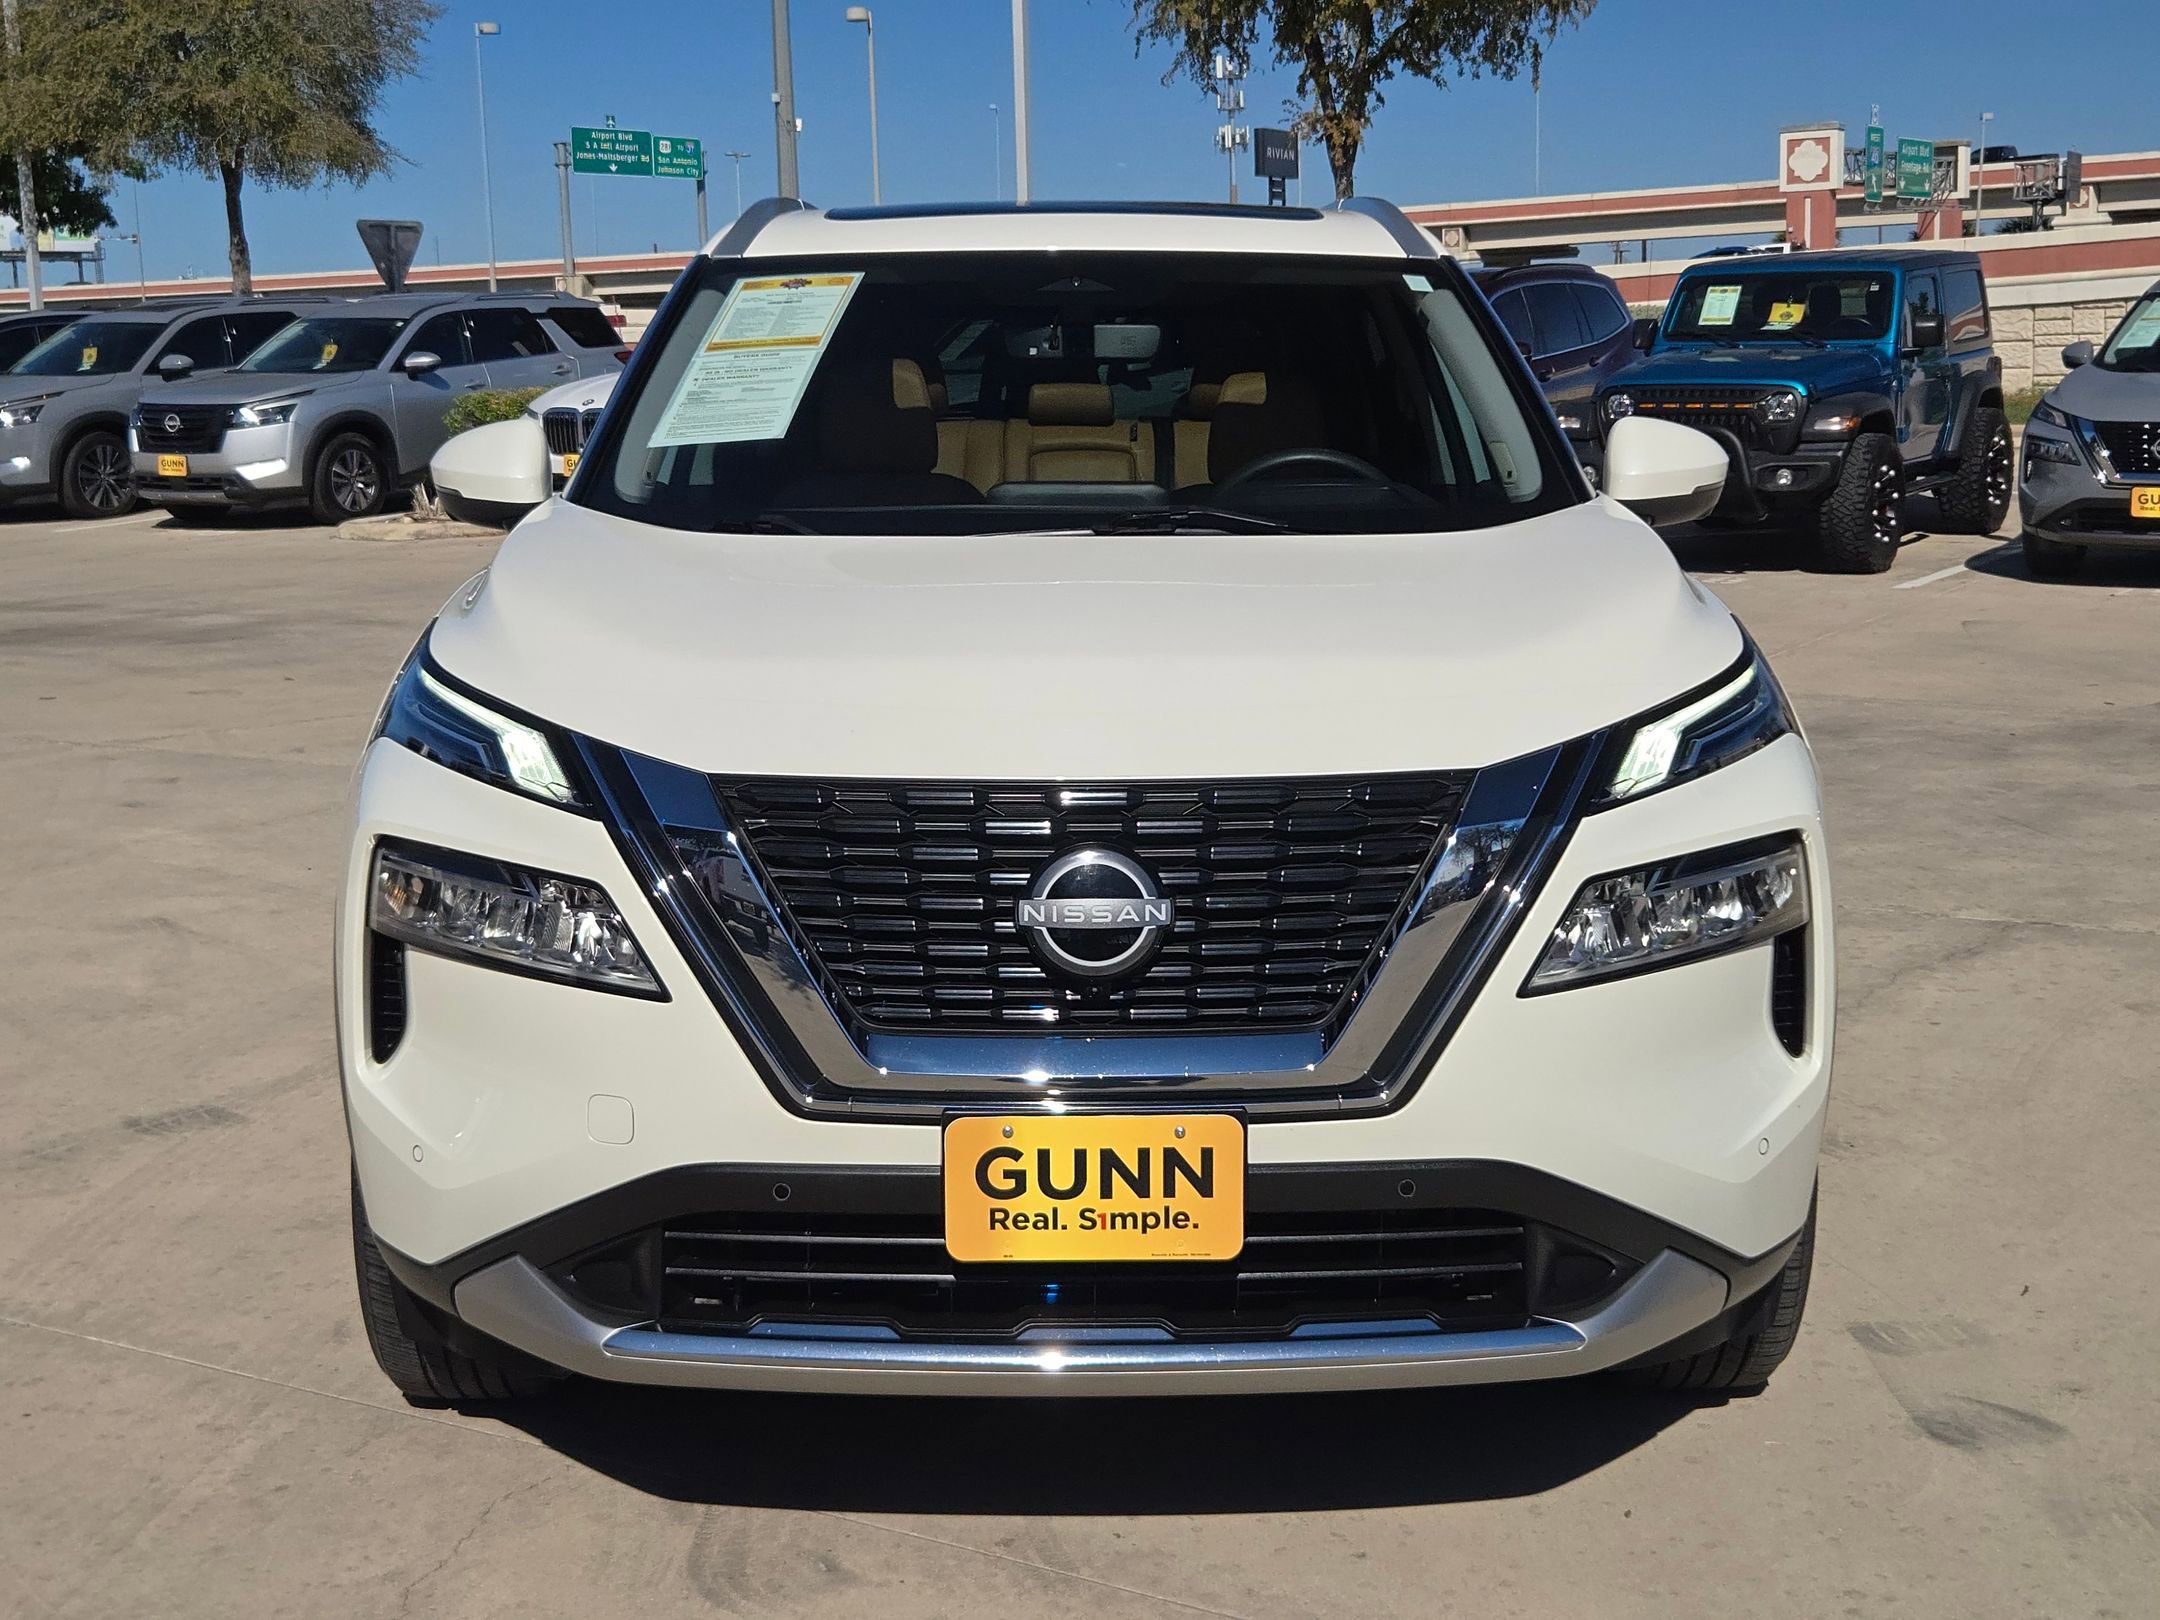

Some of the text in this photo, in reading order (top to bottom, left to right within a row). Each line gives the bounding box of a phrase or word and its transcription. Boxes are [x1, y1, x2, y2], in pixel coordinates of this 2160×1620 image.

[591, 131, 633, 141] Airport Blvd
[585, 141, 591, 149] S
[615, 143, 639, 153] Airport
[1267, 147, 1295, 161] RIVIAN
[657, 155, 698, 166] San Antonio
[686, 166, 700, 177] City
[161, 459, 184, 467] GUNN
[1023, 903, 1167, 923] NISSAN
[975, 1145, 1214, 1201] GUNN
[989, 1206, 1068, 1231] Real.
